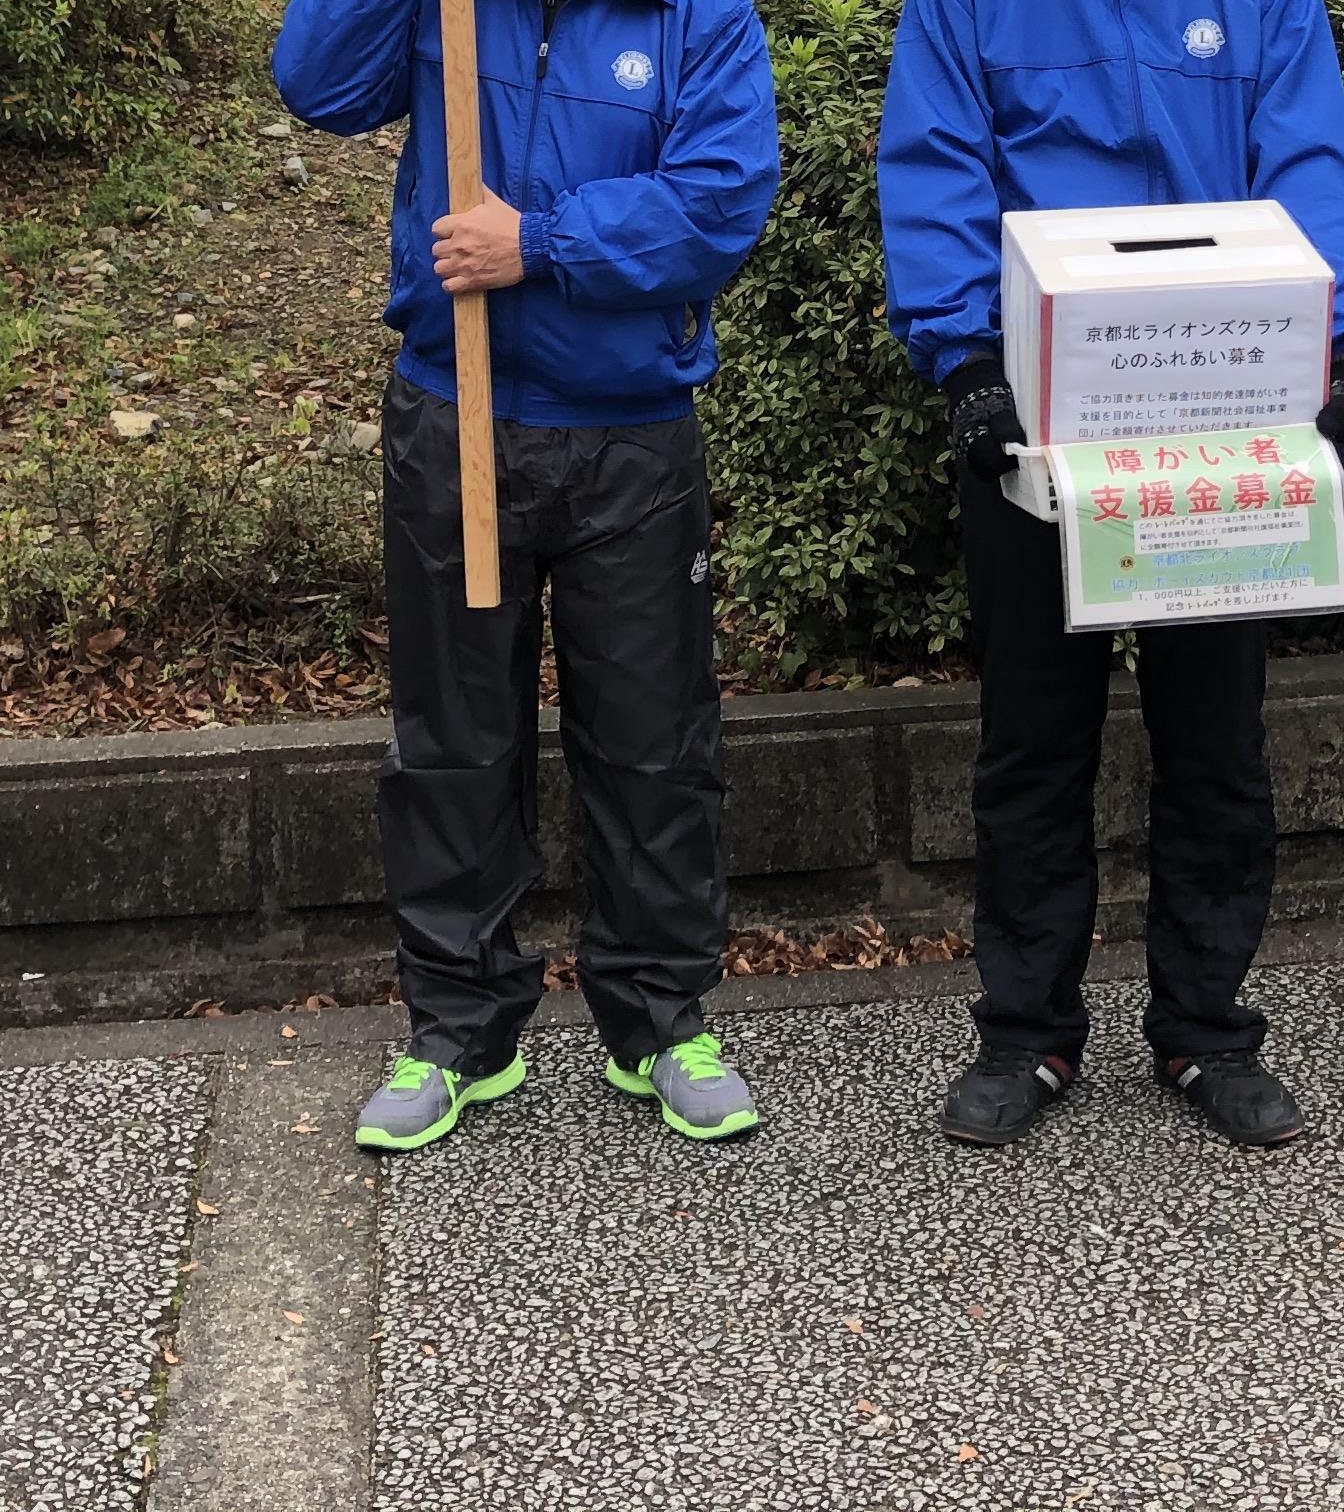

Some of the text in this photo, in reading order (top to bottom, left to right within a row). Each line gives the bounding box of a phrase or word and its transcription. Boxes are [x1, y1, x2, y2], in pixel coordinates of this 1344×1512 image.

[1086, 317, 1293, 342] 京都北ライオンズクラブ
[1111, 346, 1265, 369] 心のふれあい募金
[1105, 438, 1282, 476] 障がい者
[1091, 470, 1317, 522] 支援金募金
